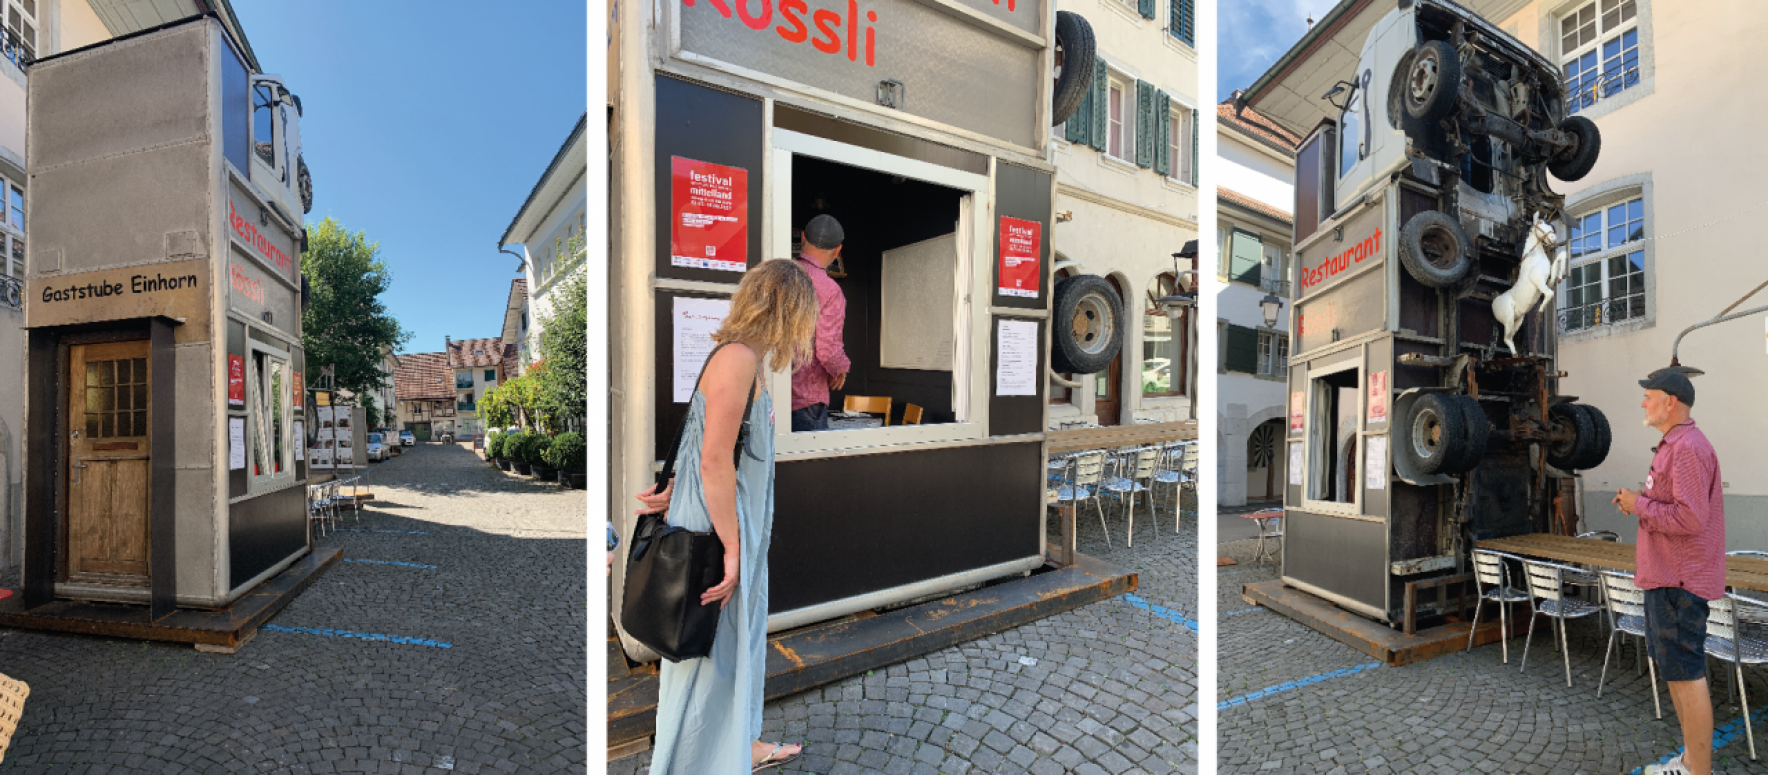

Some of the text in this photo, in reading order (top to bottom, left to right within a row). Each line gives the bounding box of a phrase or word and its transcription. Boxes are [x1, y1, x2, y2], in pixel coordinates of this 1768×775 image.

[690, 169, 732, 187] festival
[690, 186, 732, 200] mittelland
[1301, 226, 1382, 292] Restaurant
[43, 273, 197, 303] Gaststube Einhorn
